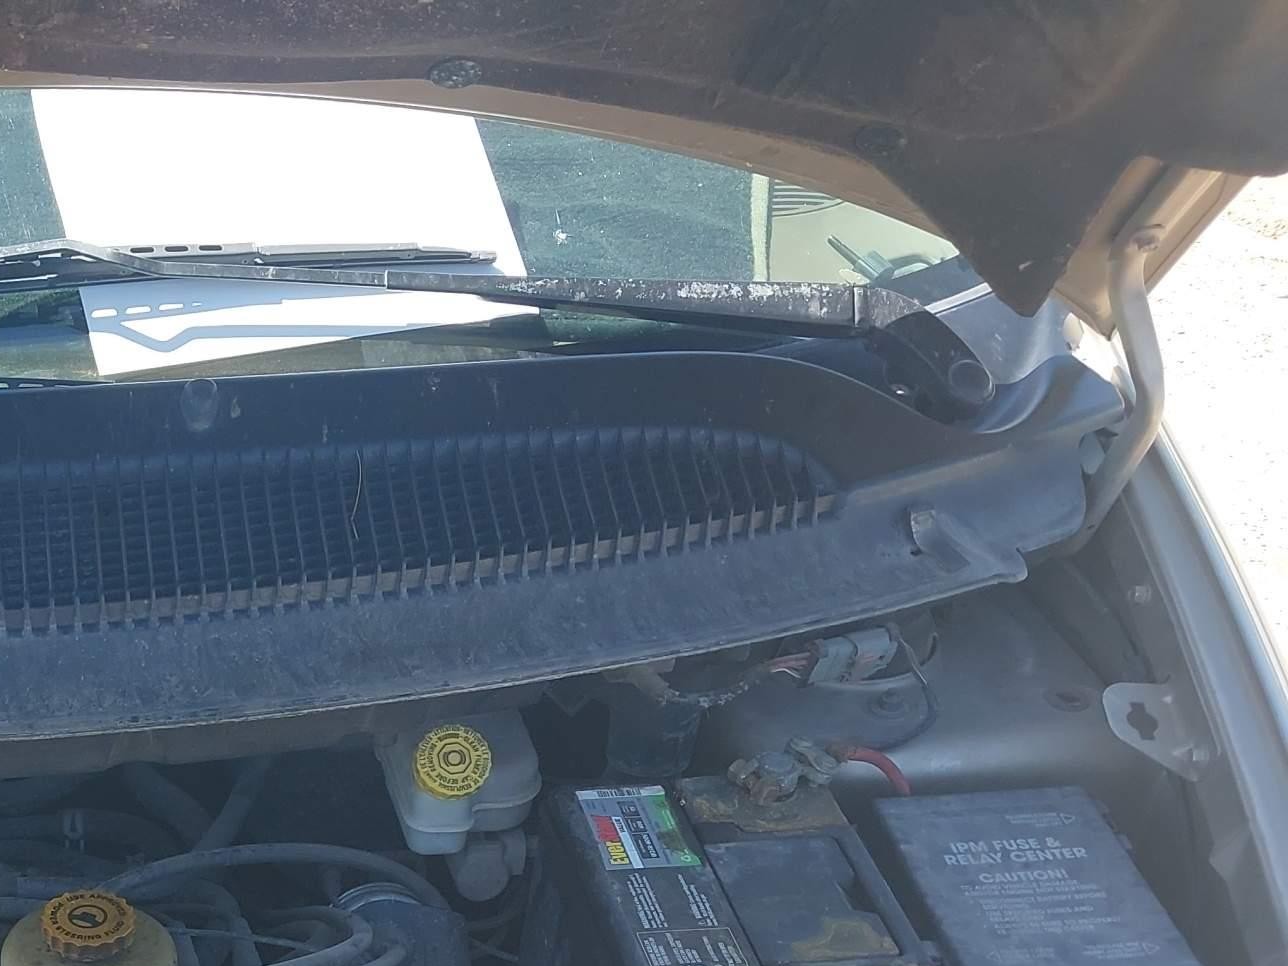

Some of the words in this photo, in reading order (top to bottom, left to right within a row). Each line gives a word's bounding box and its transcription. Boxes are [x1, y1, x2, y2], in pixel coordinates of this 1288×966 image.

[949, 841, 989, 854] IPM
[993, 838, 1040, 852] FUSE
[1046, 836, 1062, 849] &
[943, 851, 1003, 866] RELAY
[1010, 847, 1088, 863] CENTER
[979, 870, 1069, 883] CAUTION!
[66, 894, 85, 902] USE
[49, 902, 65, 925] POWER
[55, 925, 102, 941] STEERING
[103, 920, 125, 937] FLUID
